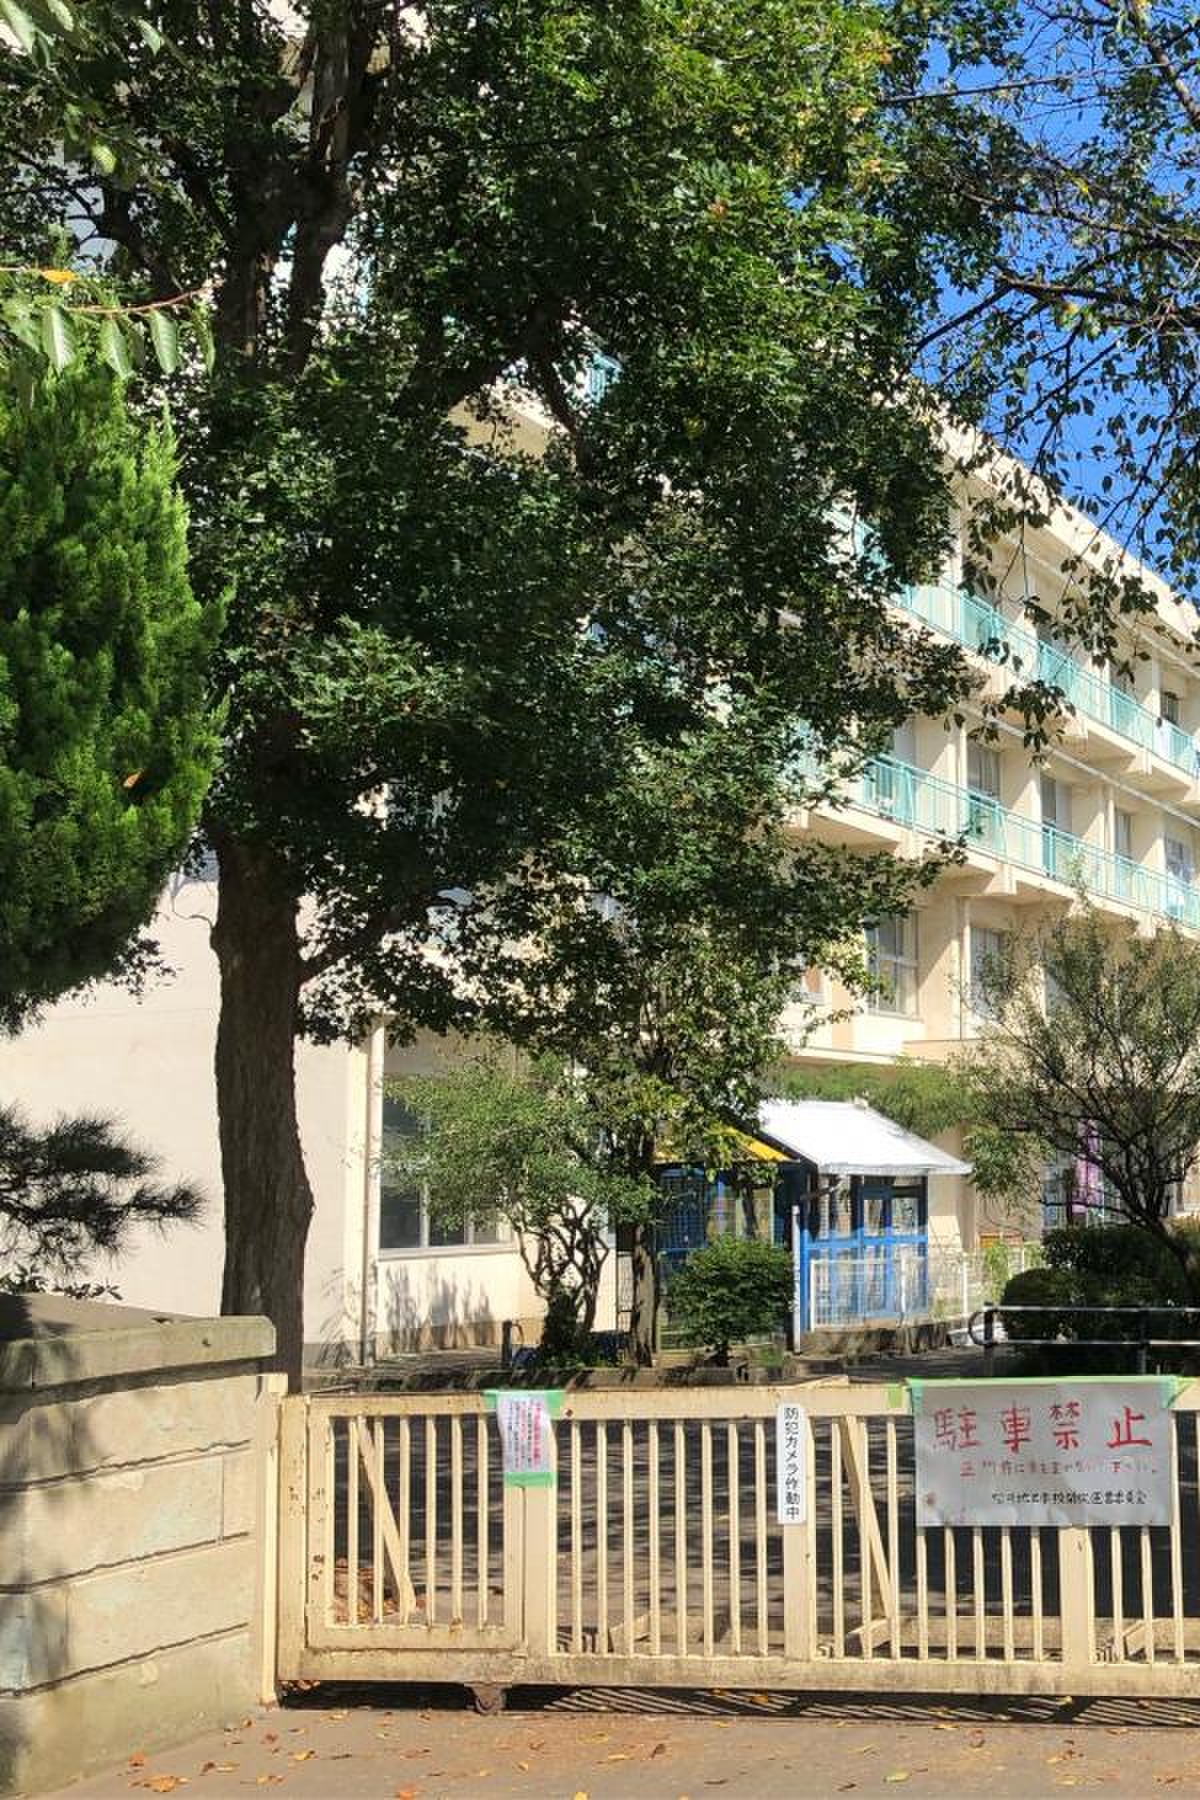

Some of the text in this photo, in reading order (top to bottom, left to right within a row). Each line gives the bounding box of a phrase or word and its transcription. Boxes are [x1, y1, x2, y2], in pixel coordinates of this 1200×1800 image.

[783, 1407, 800, 1521] 防犯カメラ作動中
[934, 1400, 1153, 1454] 駐車禁止
